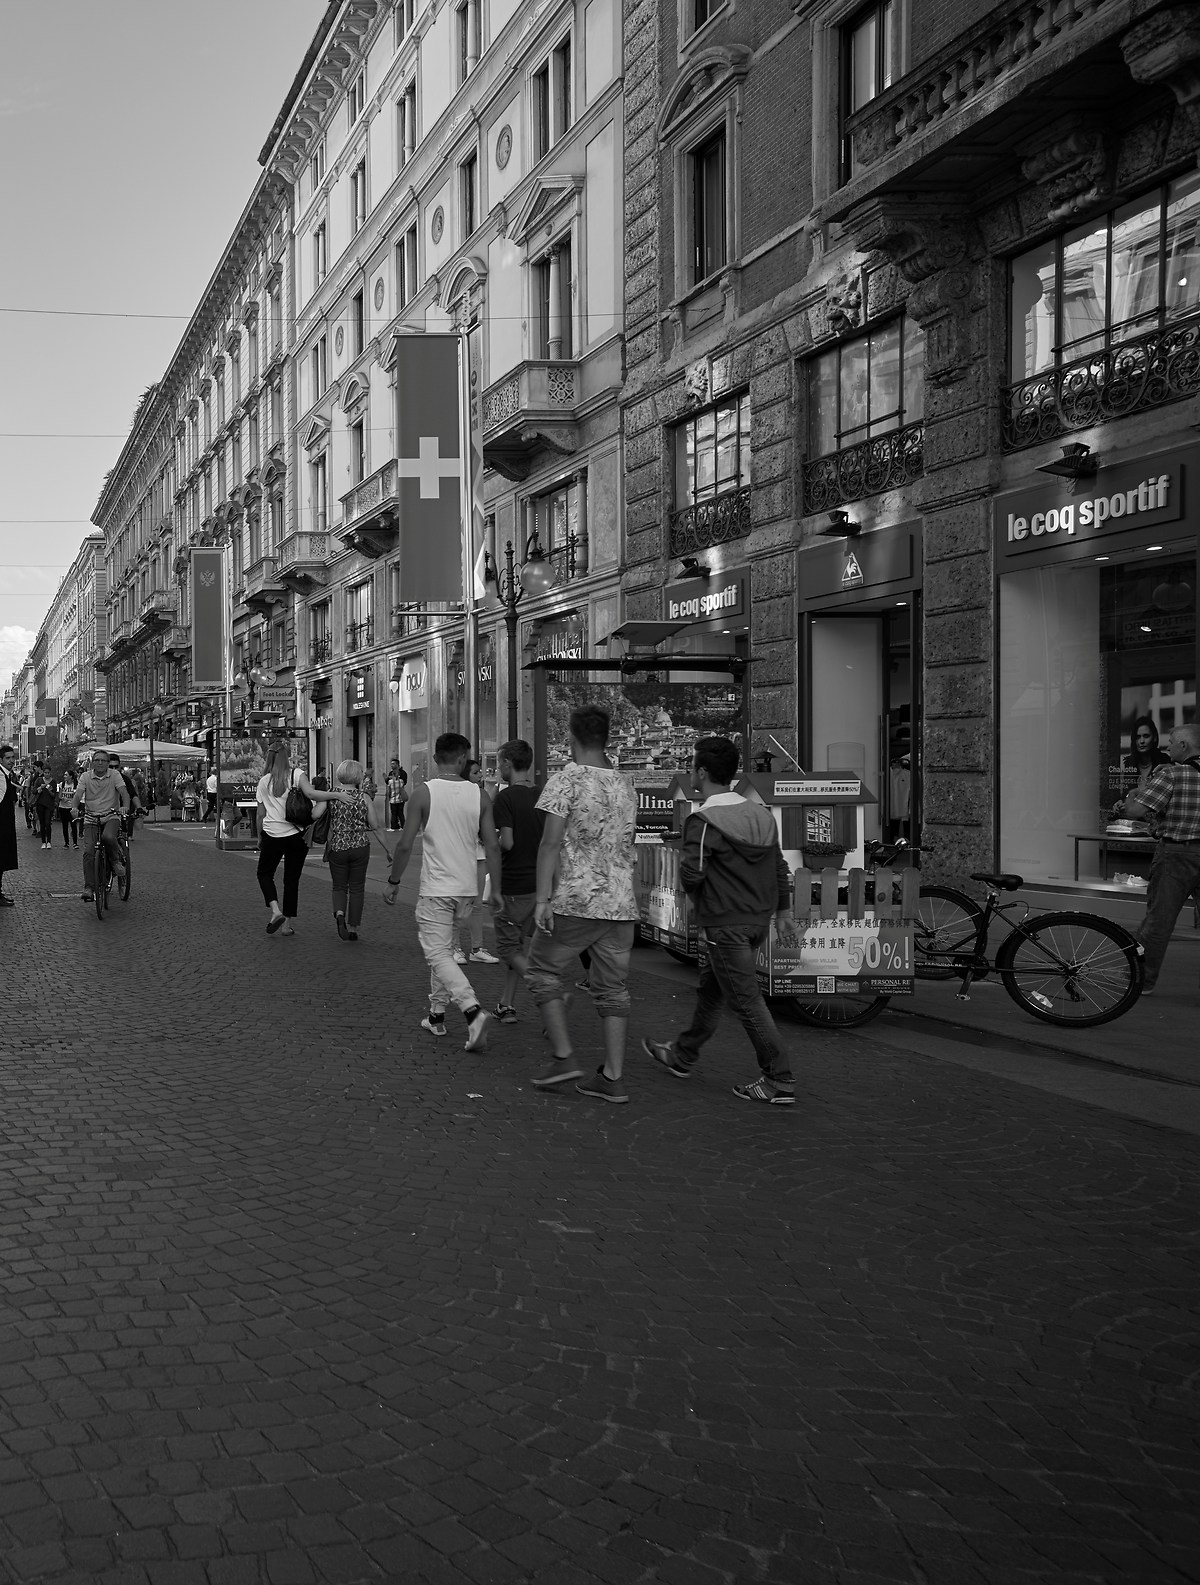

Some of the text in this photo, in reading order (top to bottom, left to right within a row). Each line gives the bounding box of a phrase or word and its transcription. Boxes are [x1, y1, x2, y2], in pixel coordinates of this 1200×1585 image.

[1007, 474, 1170, 542] le coq sportif
[669, 584, 738, 619] le coq sportif
